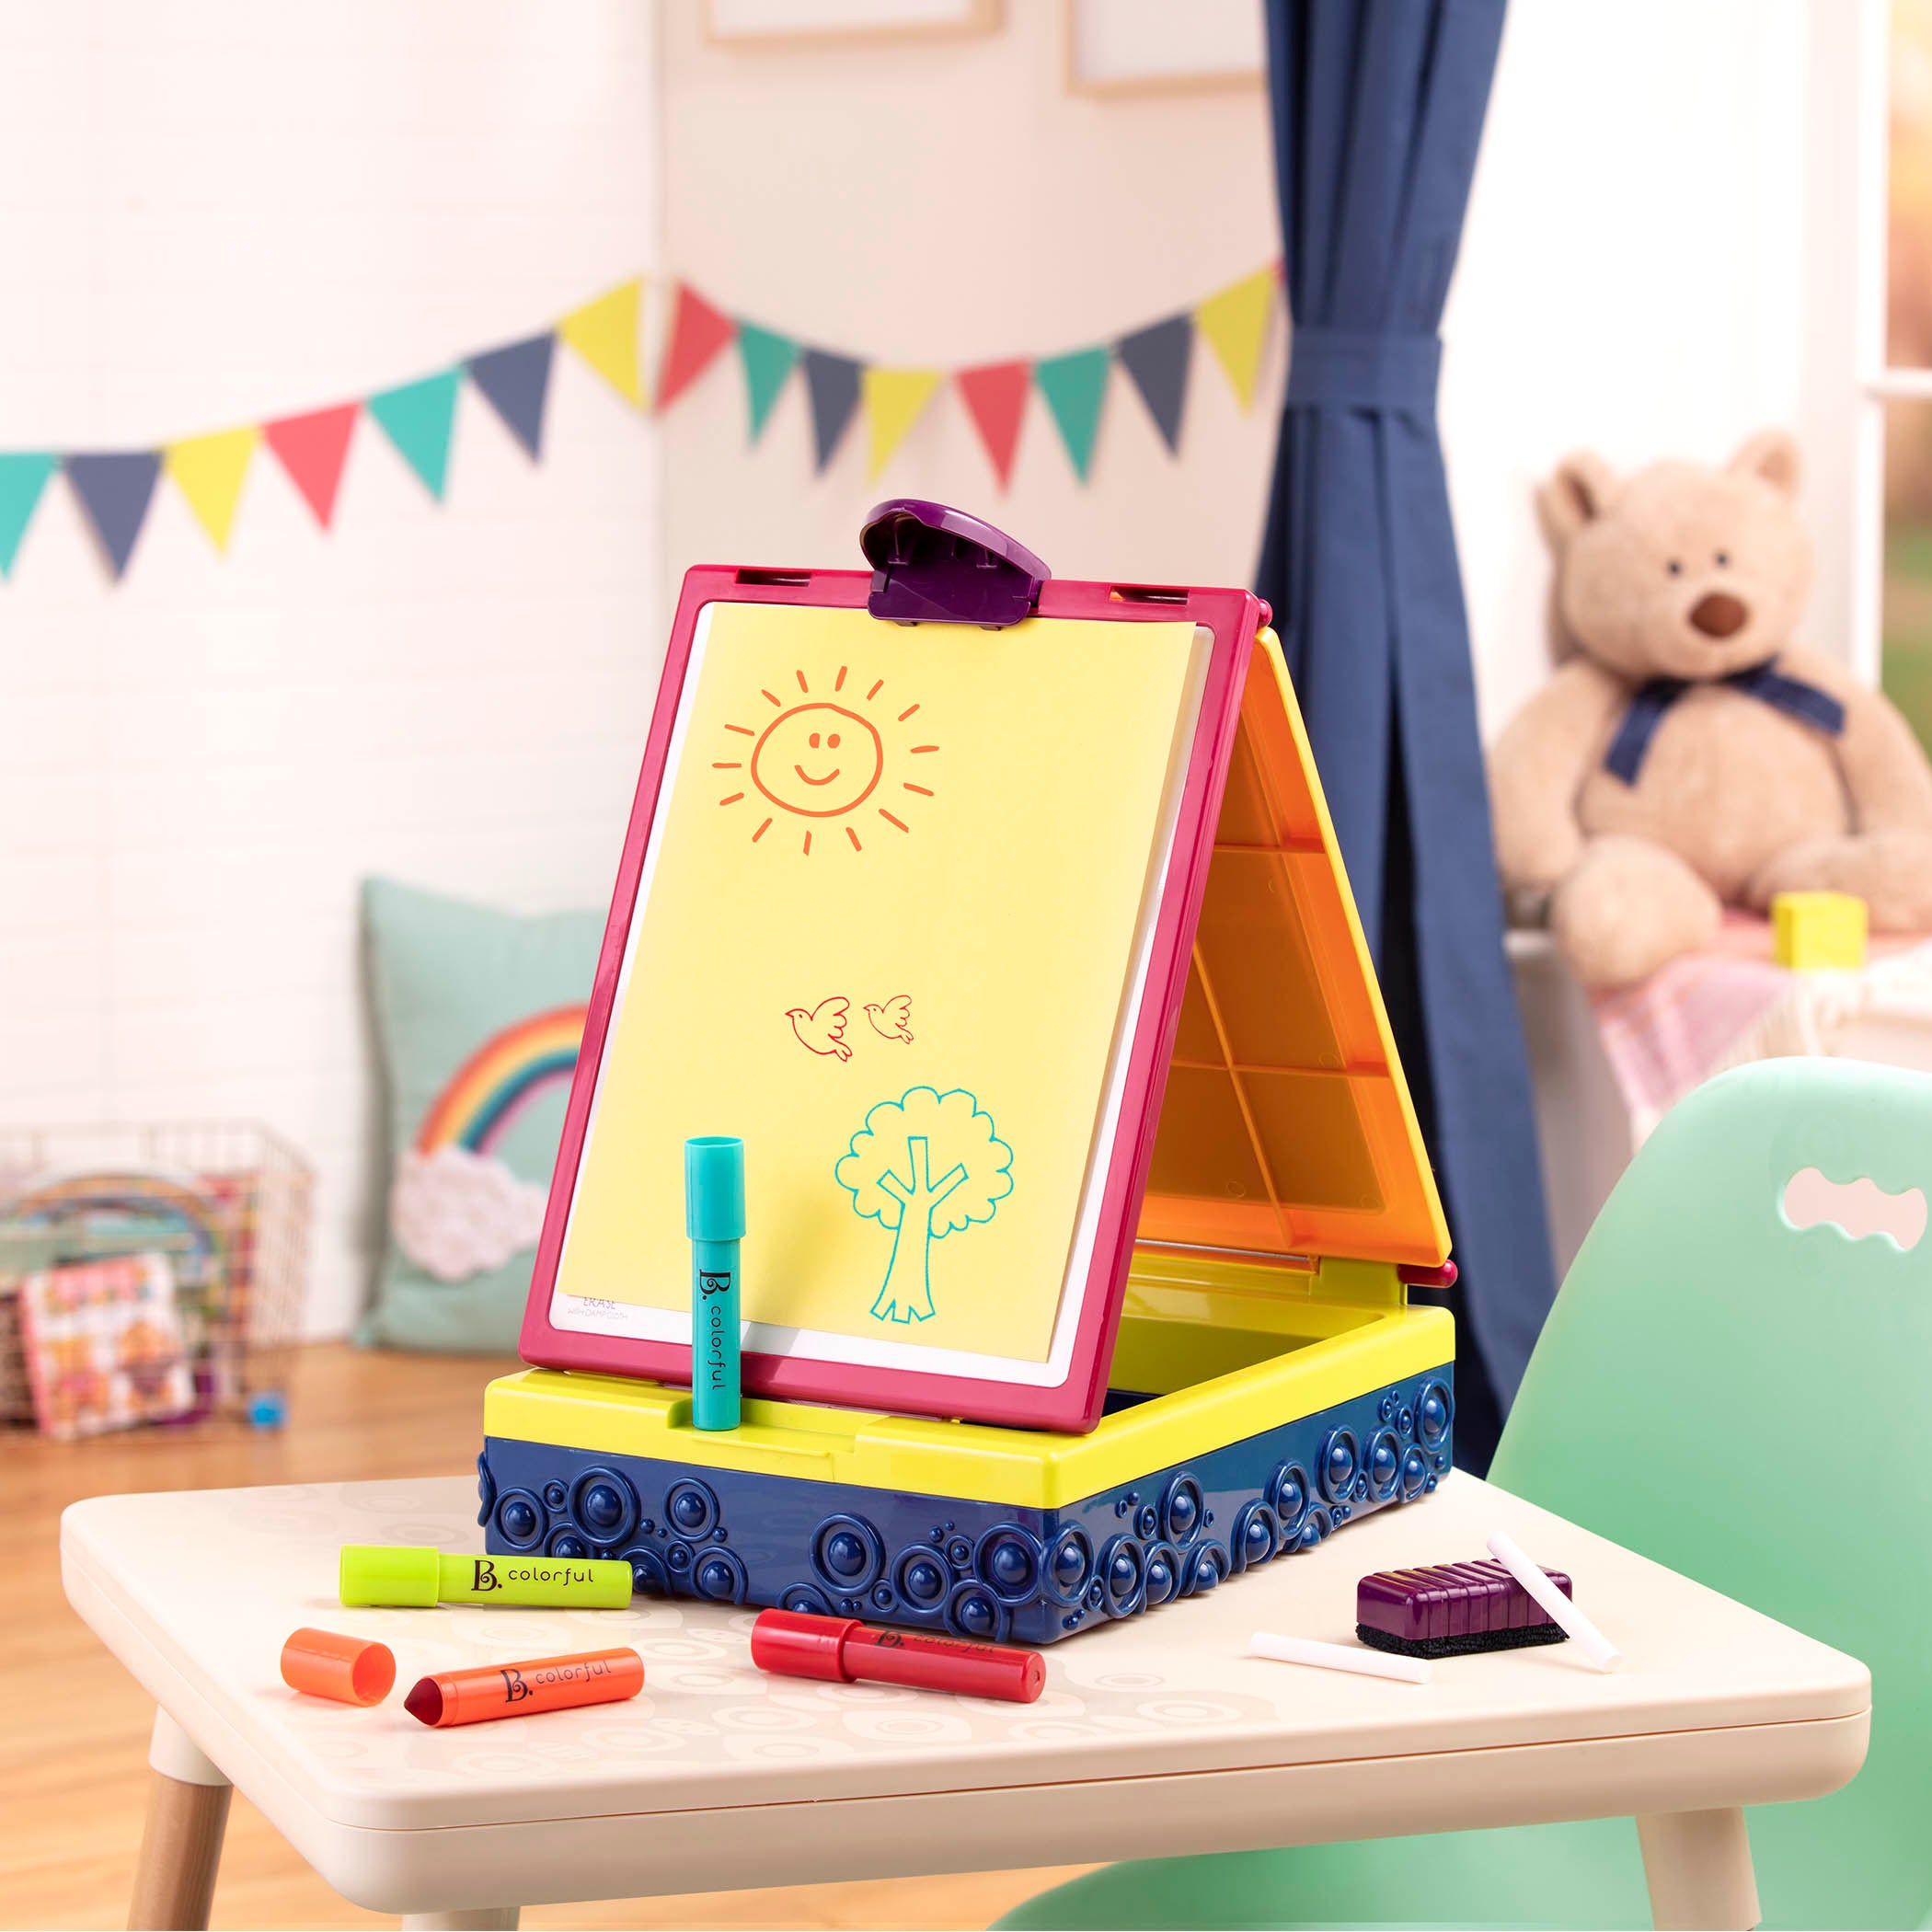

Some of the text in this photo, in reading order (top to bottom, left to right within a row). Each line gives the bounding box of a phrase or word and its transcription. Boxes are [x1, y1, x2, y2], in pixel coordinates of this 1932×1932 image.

[699, 1269, 731, 1390] B. colorful
[471, 1559, 594, 1592] B. colorful
[500, 1660, 612, 1703] B. colorful
